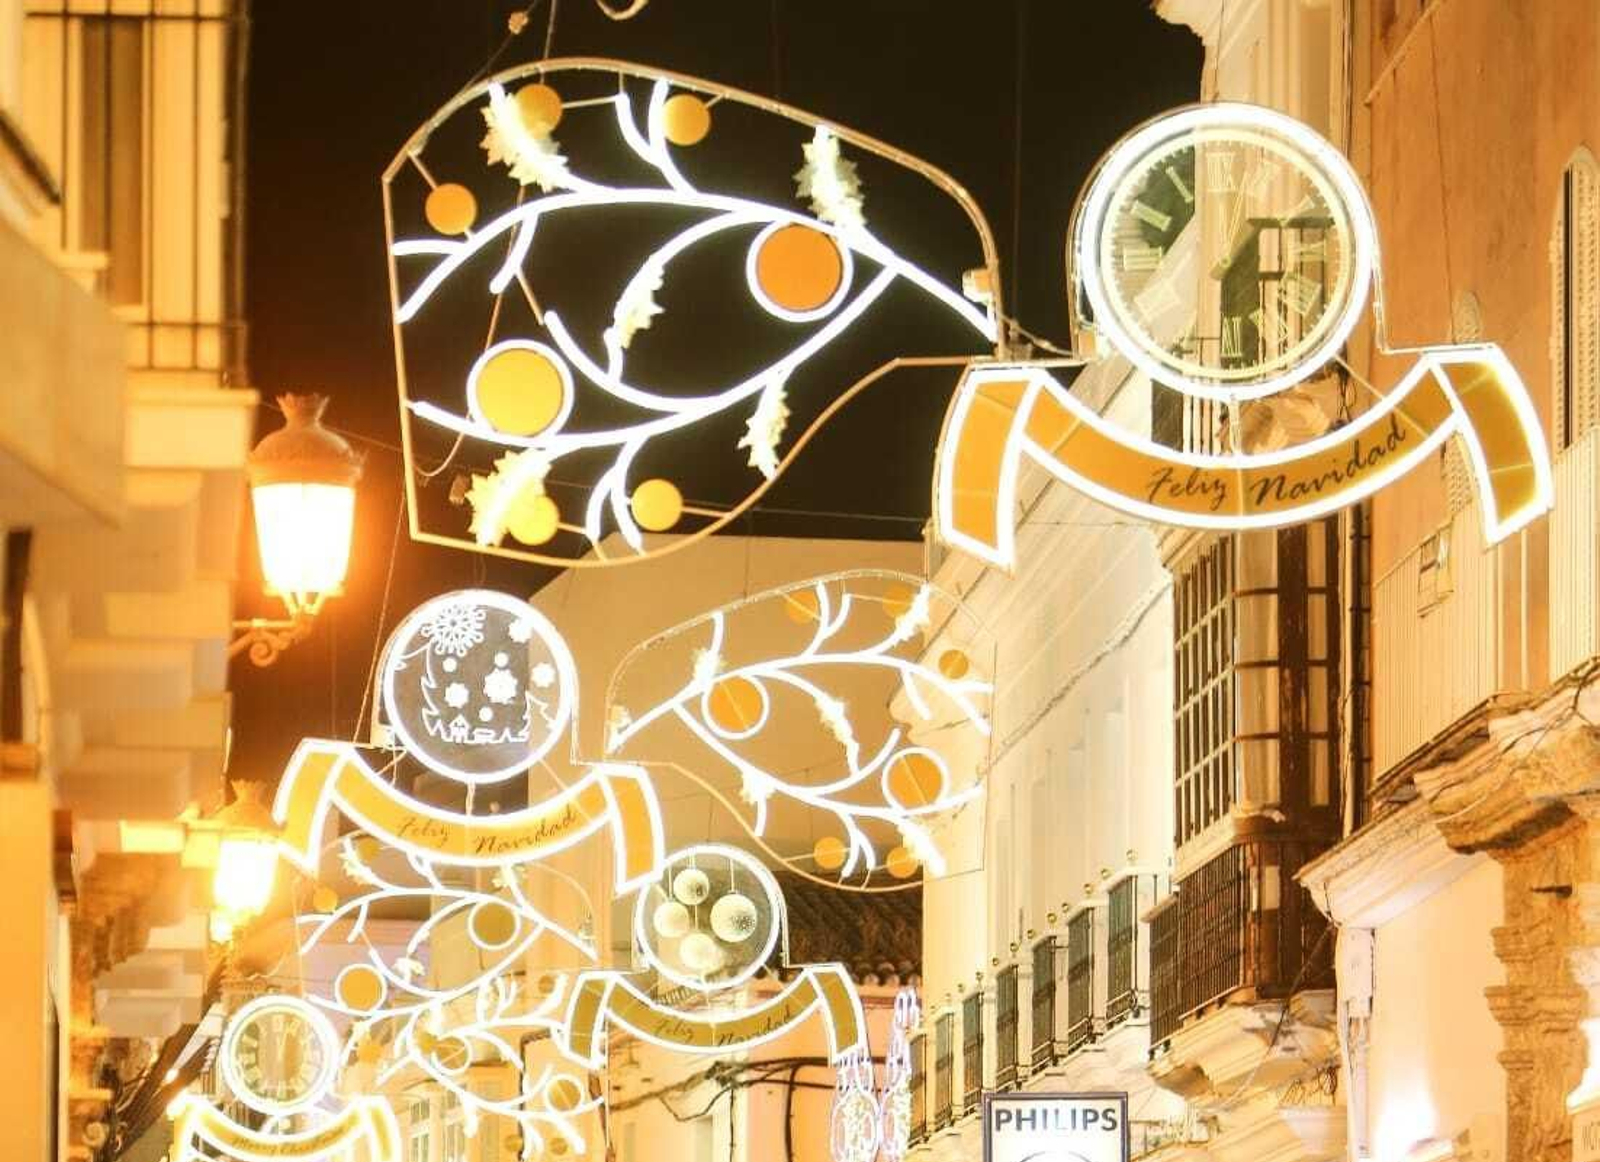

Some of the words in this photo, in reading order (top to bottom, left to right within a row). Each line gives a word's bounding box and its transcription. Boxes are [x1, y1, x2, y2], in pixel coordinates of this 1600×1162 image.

[1147, 466, 1227, 511] Feliz
[1250, 413, 1407, 506] Navidad
[996, 1108, 1118, 1132] PHILIPS
